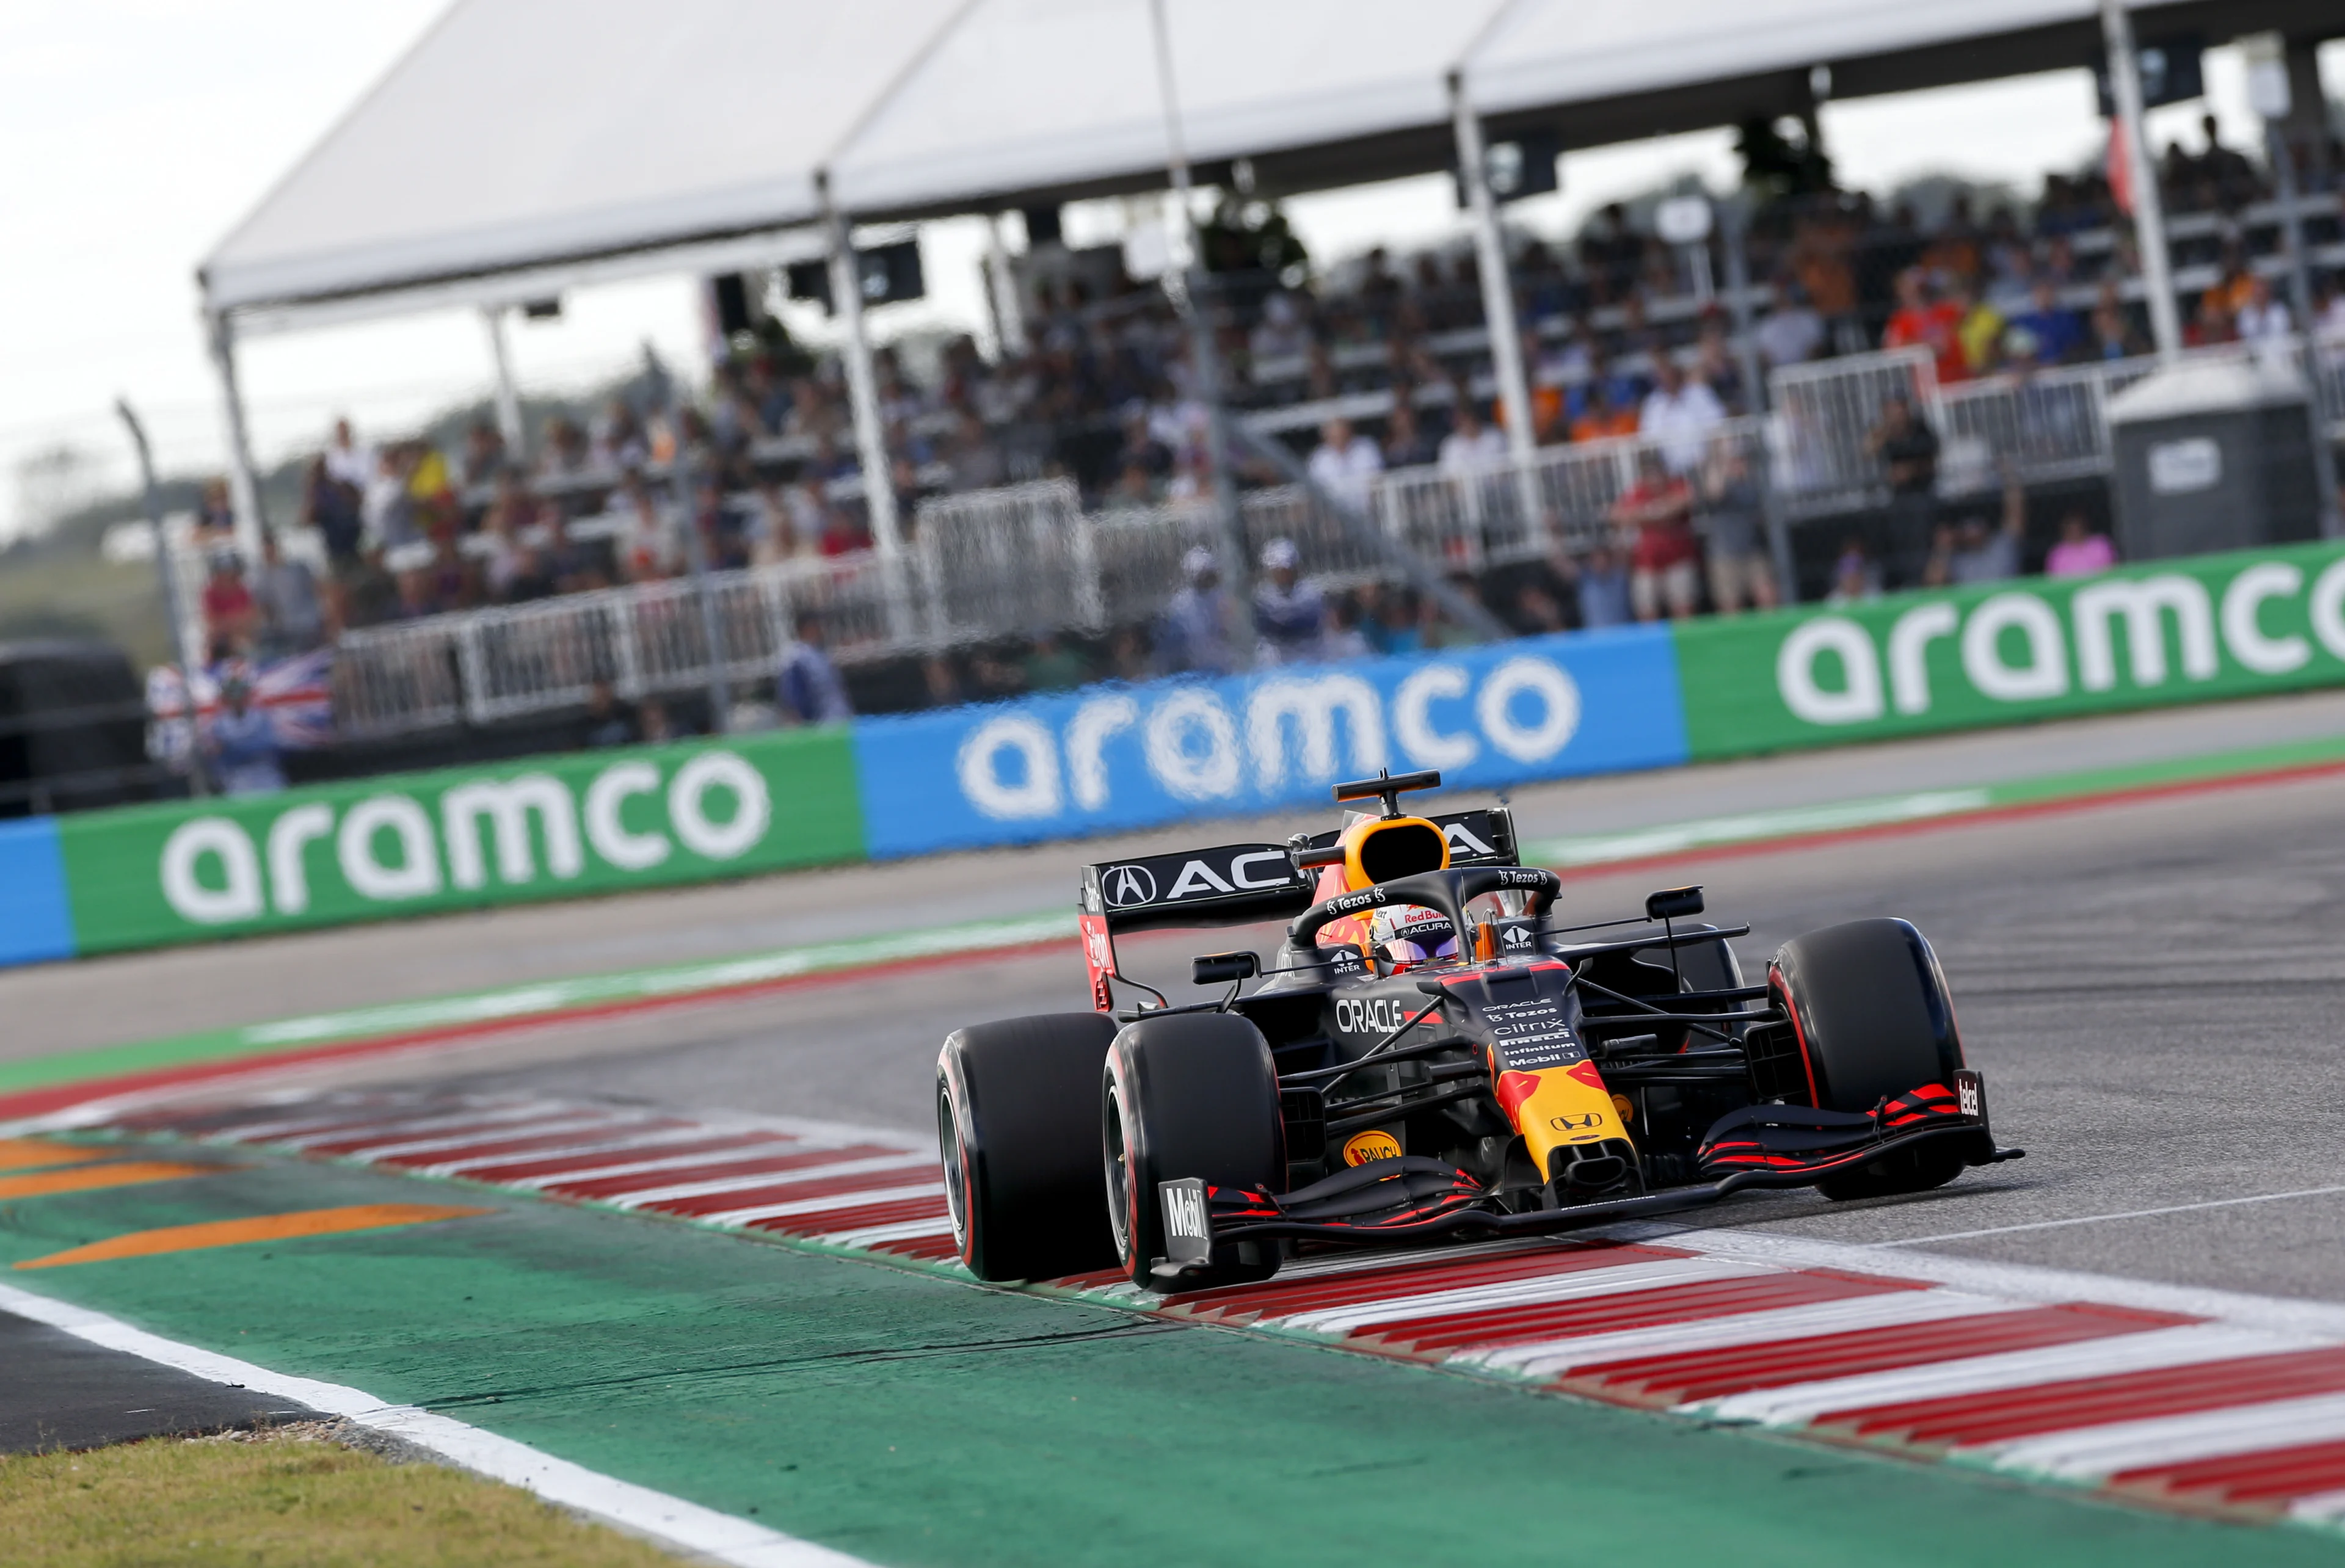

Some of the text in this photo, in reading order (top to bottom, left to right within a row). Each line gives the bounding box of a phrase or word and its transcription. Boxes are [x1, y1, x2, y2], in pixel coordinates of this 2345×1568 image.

[956, 655, 1581, 819] aramco
[159, 751, 771, 924] aramco
[1509, 871, 1538, 884] Tezos
[1337, 893, 1372, 910] Tezos
[1405, 910, 1424, 924] Red
[1409, 922, 1452, 935] ACURA
[1505, 941, 1533, 950] INTER
[1334, 964, 1361, 975] INTER
[1482, 998, 1552, 1012] ORACLE
[1336, 999, 1402, 1033] ORACLE
[1505, 1007, 1558, 1019] Tezos
[1494, 1018, 1565, 1035] citrix
[1499, 1030, 1570, 1047] PIRELLI
[1503, 1042, 1576, 1056] infinitum
[1509, 1053, 1561, 1067] Mobil
[1958, 1078, 1979, 1117] telcel
[1166, 1188, 1203, 1238] Mobil
